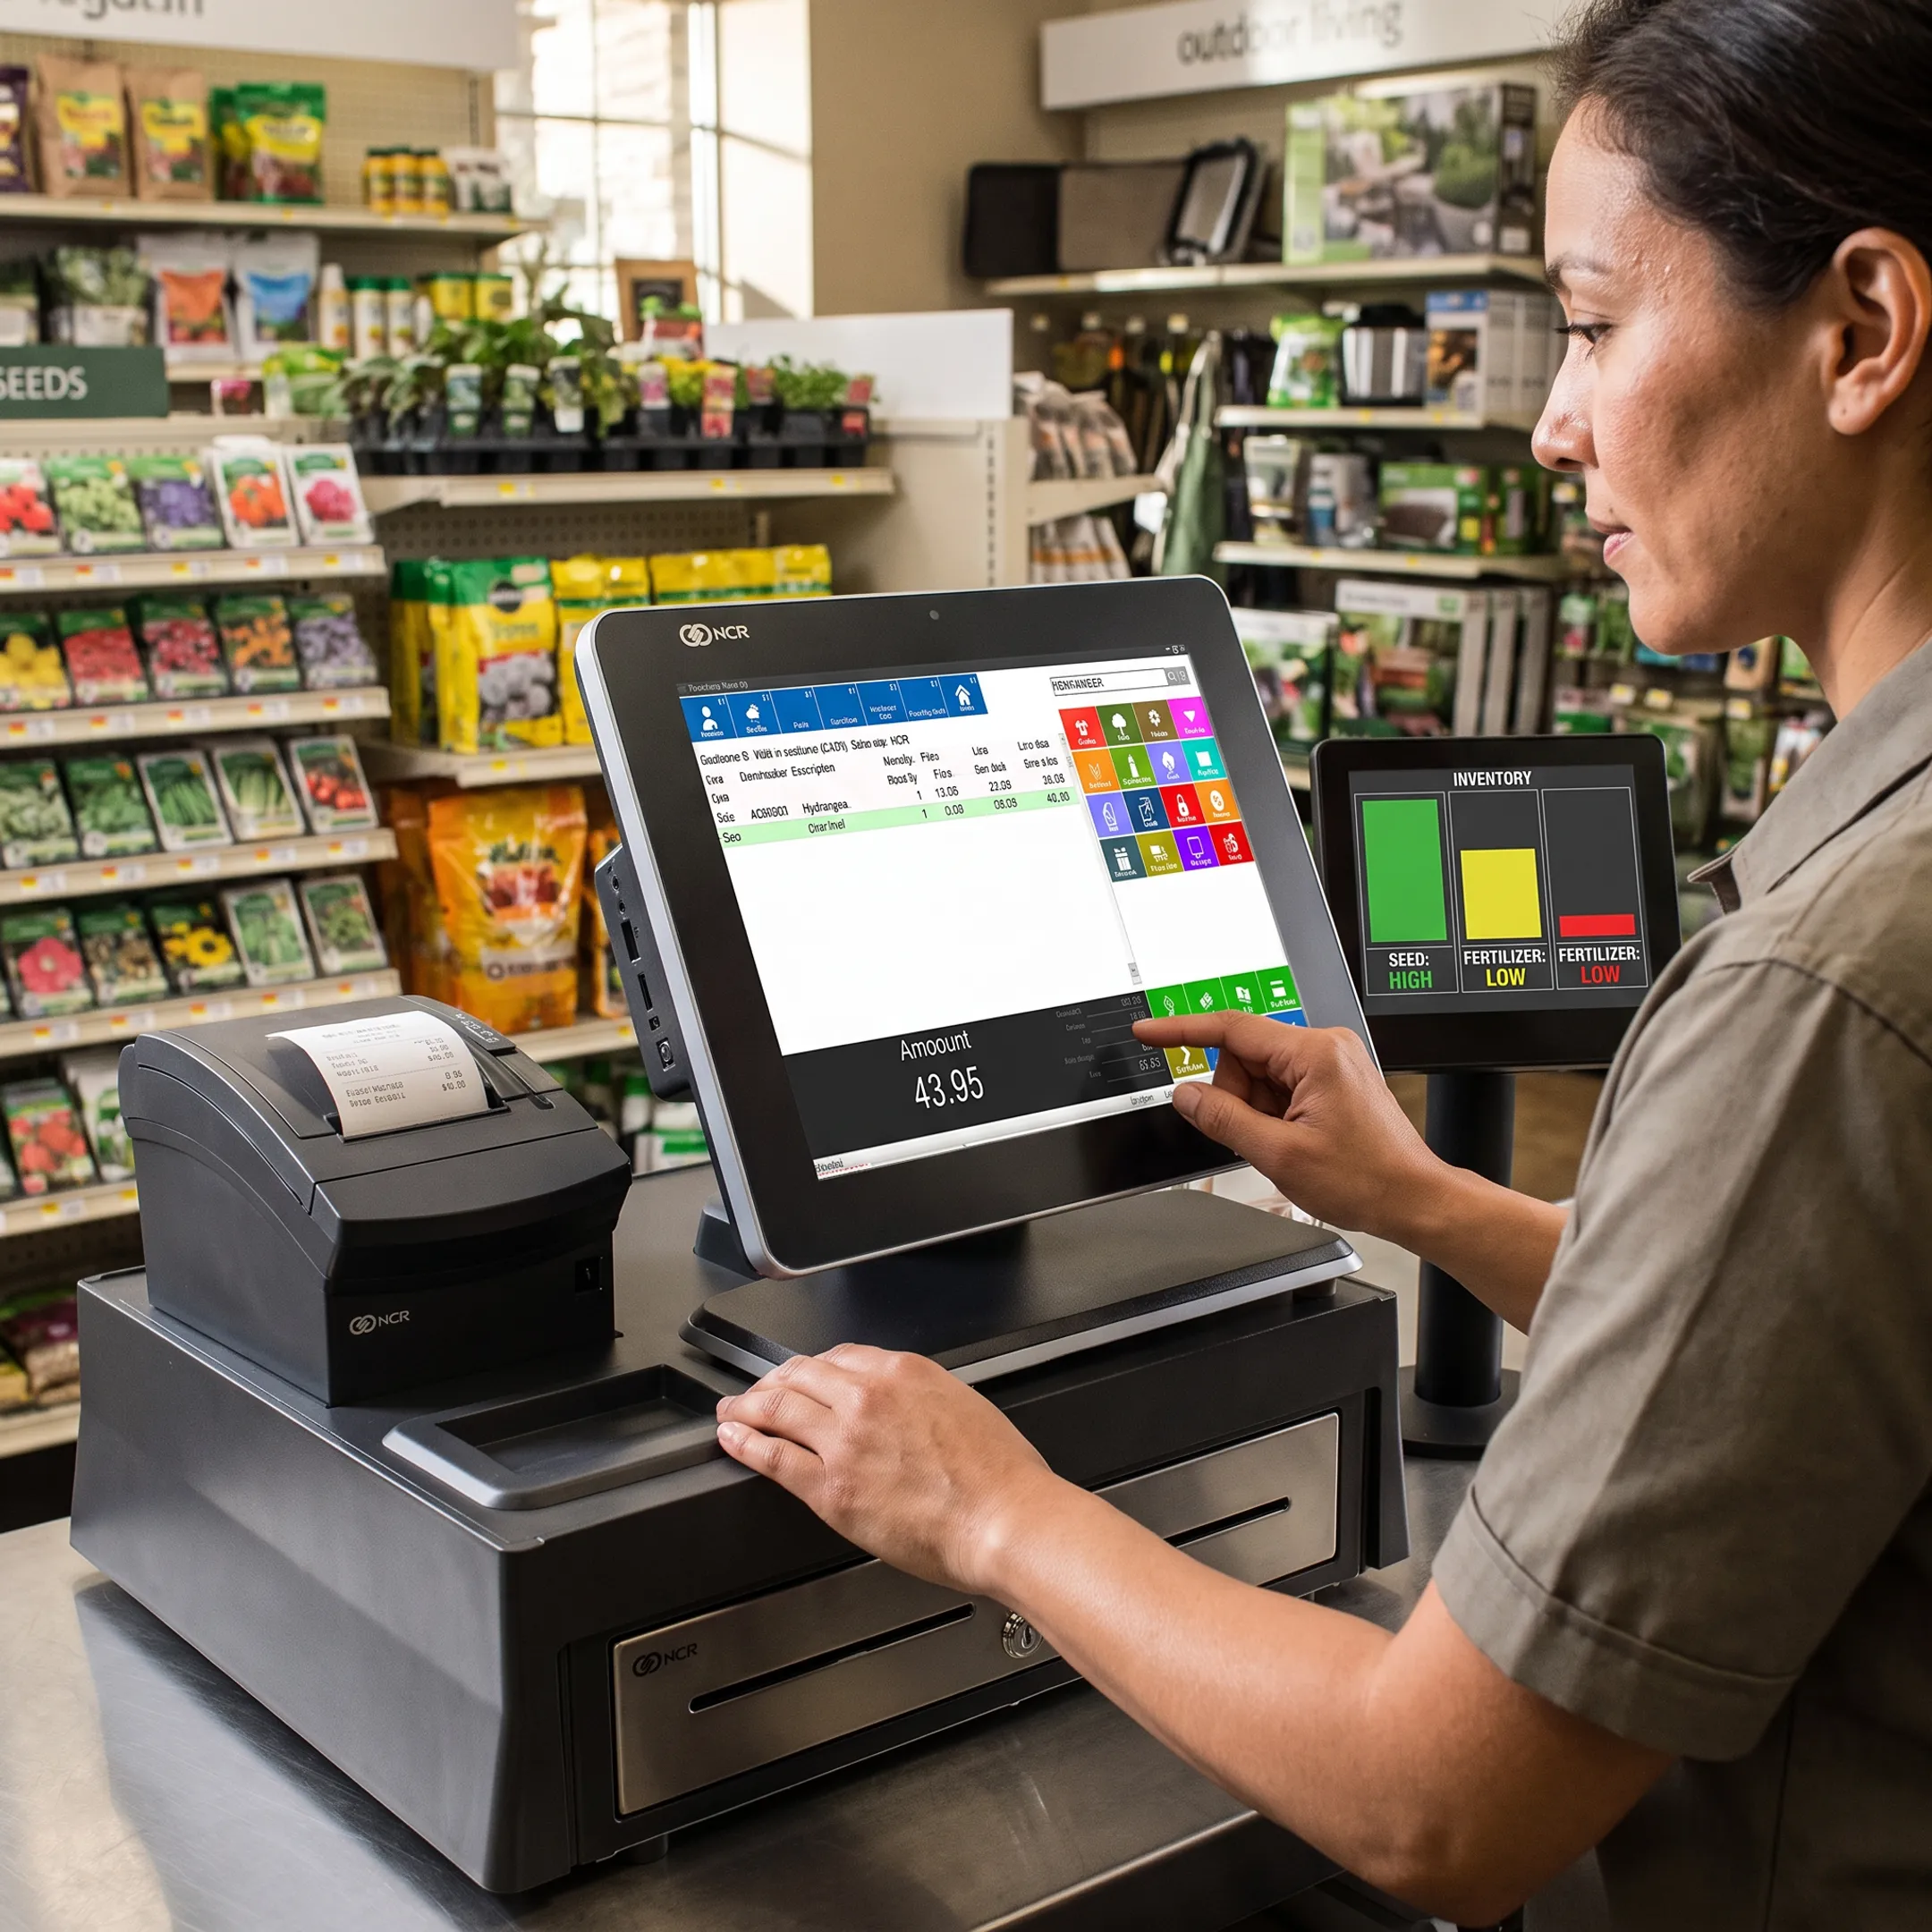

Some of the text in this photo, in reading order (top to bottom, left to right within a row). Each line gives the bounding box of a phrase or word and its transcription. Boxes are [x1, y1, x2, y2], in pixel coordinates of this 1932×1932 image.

[712, 625, 750, 640] NCR
[1453, 770, 1532, 787] INVENTORY
[917, 790, 922, 801] 1
[921, 809, 928, 819] 1
[1388, 952, 1429, 967] SEED:
[1463, 948, 1546, 965] FERTILIZER:
[1559, 945, 1640, 962] FERTILIZER:
[1389, 970, 1432, 989] HIGH
[1486, 968, 1526, 987] LOW
[1580, 965, 1620, 984] LOW
[901, 1030, 972, 1062] Amoount
[914, 1065, 984, 1109] 43.95
[378, 1310, 411, 1327] NCR
[664, 1642, 698, 1665] NCR
